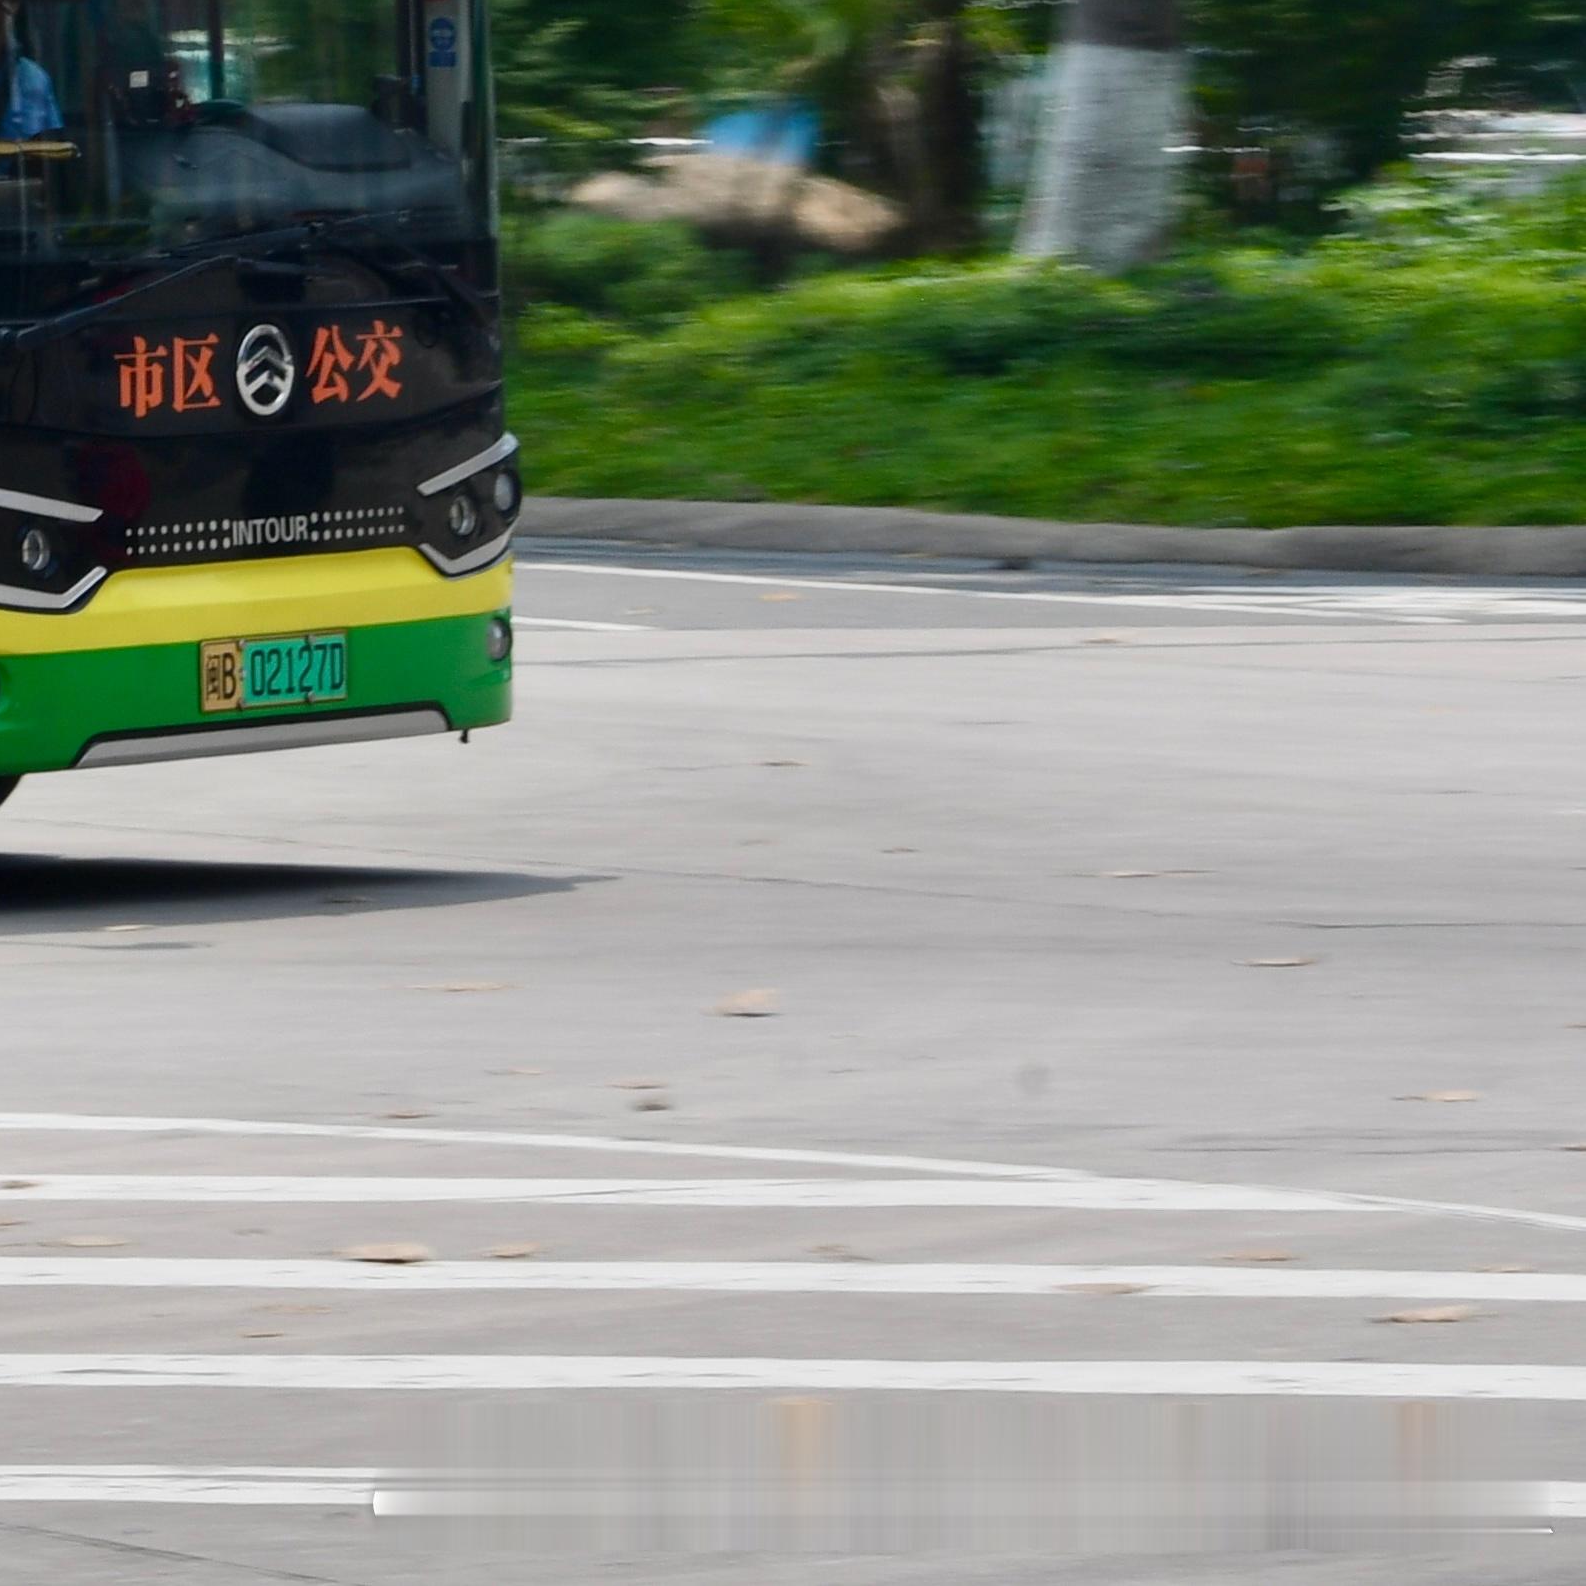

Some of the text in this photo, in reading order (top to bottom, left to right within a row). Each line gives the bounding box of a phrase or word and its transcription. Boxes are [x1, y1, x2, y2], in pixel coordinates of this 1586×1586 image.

[113, 319, 404, 418] 市区 公交
[231, 515, 309, 547] INTOUR
